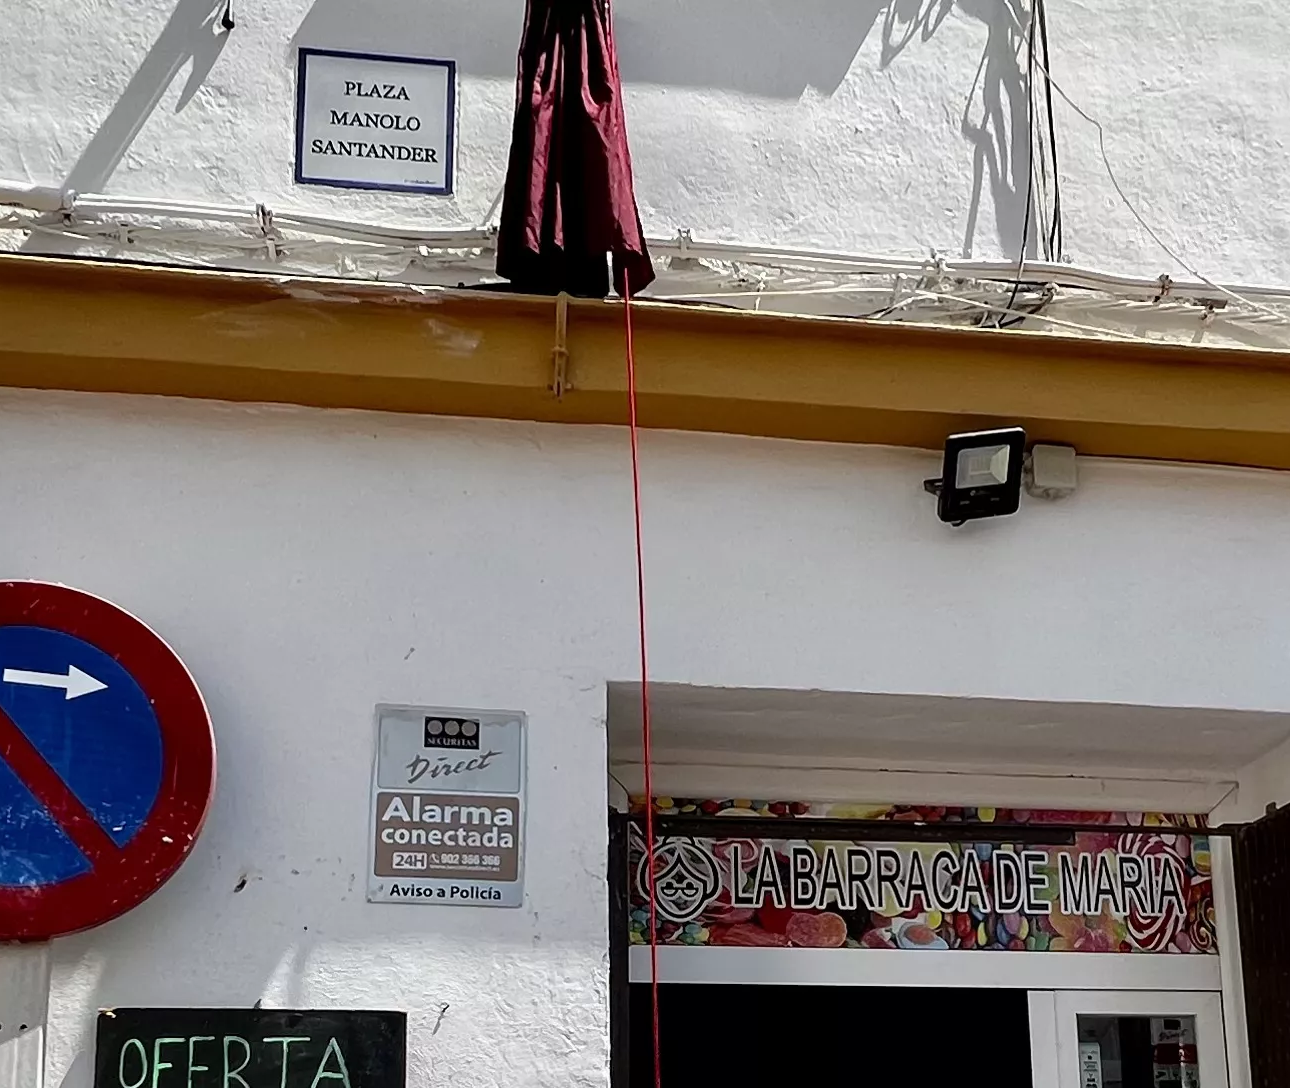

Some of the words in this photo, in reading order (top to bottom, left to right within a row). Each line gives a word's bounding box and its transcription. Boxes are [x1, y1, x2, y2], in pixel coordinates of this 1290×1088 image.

[344, 81, 410, 101] PLAZA
[330, 110, 421, 132] MANOLO
[311, 139, 438, 163] SANTANDER
[405, 750, 503, 784] Direct
[381, 796, 513, 826] Alarma
[381, 827, 513, 848] conectada
[395, 854, 425, 867] 24H
[730, 843, 786, 908] LA
[791, 844, 990, 913] BARRACA
[992, 849, 1052, 914] DE
[1058, 851, 1187, 915] MARIA
[390, 884, 433, 898] Aviso
[437, 888, 446, 898] a
[450, 885, 501, 900] Policía
